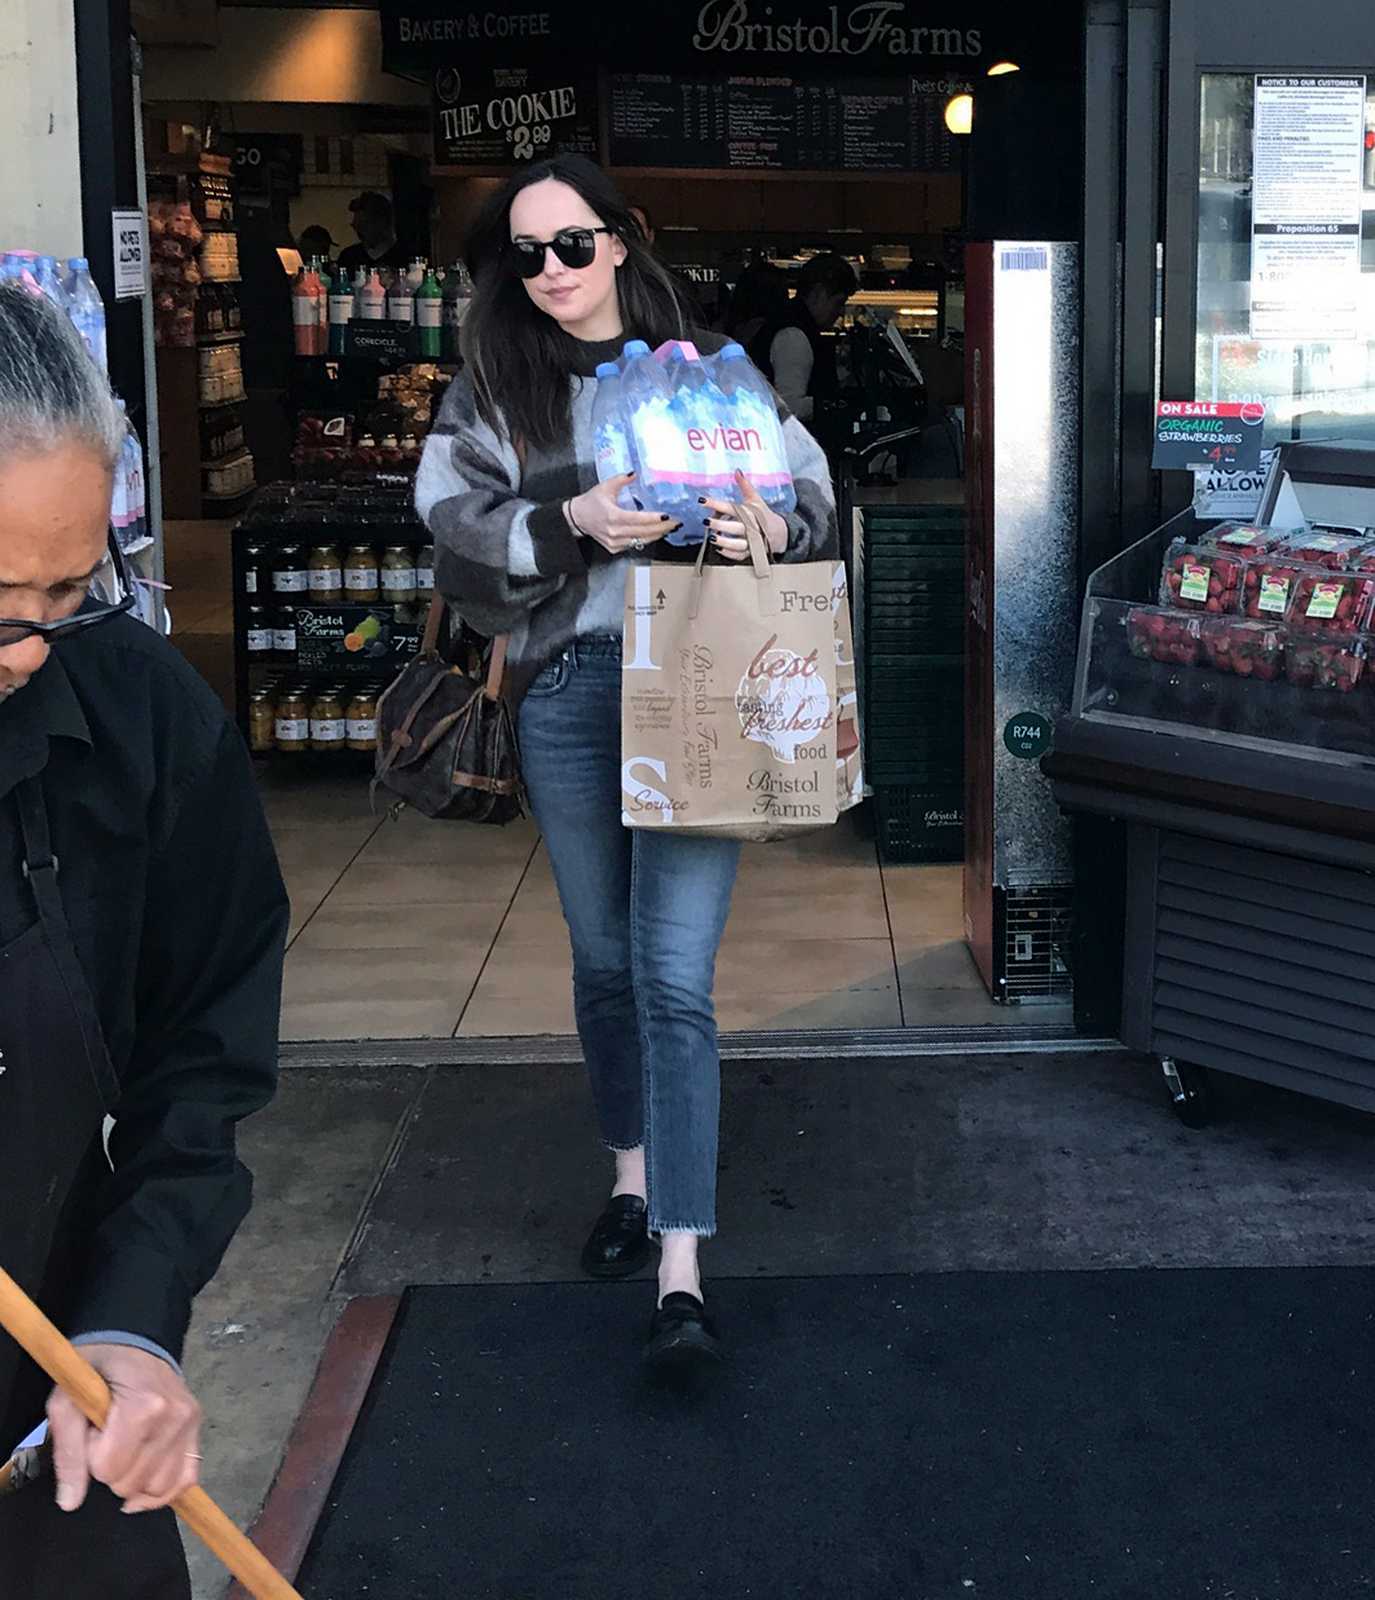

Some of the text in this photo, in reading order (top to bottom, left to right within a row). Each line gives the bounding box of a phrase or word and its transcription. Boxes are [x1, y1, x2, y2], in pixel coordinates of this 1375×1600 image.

[467, 12, 481, 39] &
[692, 0, 984, 56] Bristol Farms
[439, 103, 483, 140] THE
[486, 86, 577, 131] COOKIE
[1276, 224, 1339, 234] Proposition 65
[1160, 403, 1218, 416] ON SALE
[687, 424, 762, 451] evian
[1158, 419, 1224, 433] ORGANIC
[1158, 431, 1243, 443] STRAWBERRIES
[1206, 477, 1264, 491] ALLOW
[779, 590, 834, 613] Fre
[296, 608, 344, 626] Bristol
[303, 624, 345, 637] Farms
[748, 633, 818, 679] best
[693, 644, 718, 789] Bristol Farms
[740, 702, 834, 739] freshest
[1013, 726, 1041, 739] R744
[794, 744, 828, 760] food
[746, 768, 819, 793] Bristol
[630, 789, 690, 812] Service
[752, 793, 822, 818] Farms
